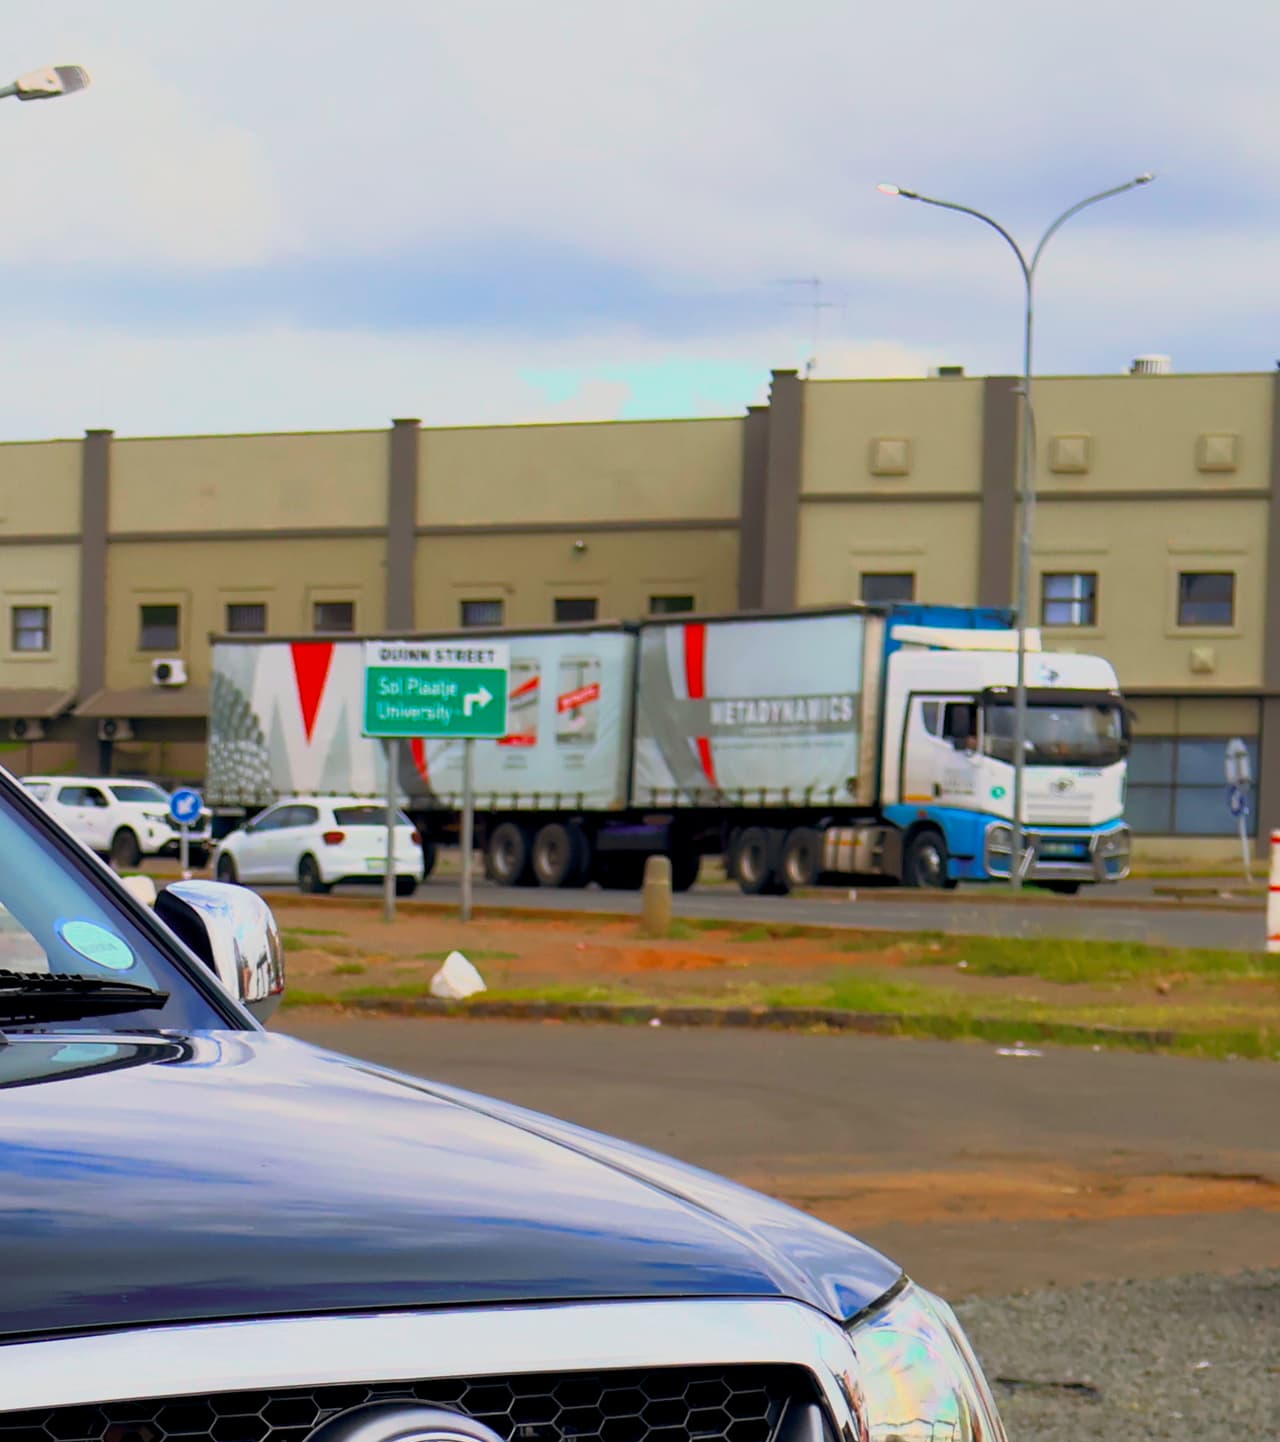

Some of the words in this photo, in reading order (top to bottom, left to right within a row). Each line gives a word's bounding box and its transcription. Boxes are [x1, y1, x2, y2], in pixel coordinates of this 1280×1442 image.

[379, 648, 431, 663] QUINN
[435, 649, 496, 664] STREET
[377, 675, 404, 696] Sol
[376, 701, 452, 727] University
